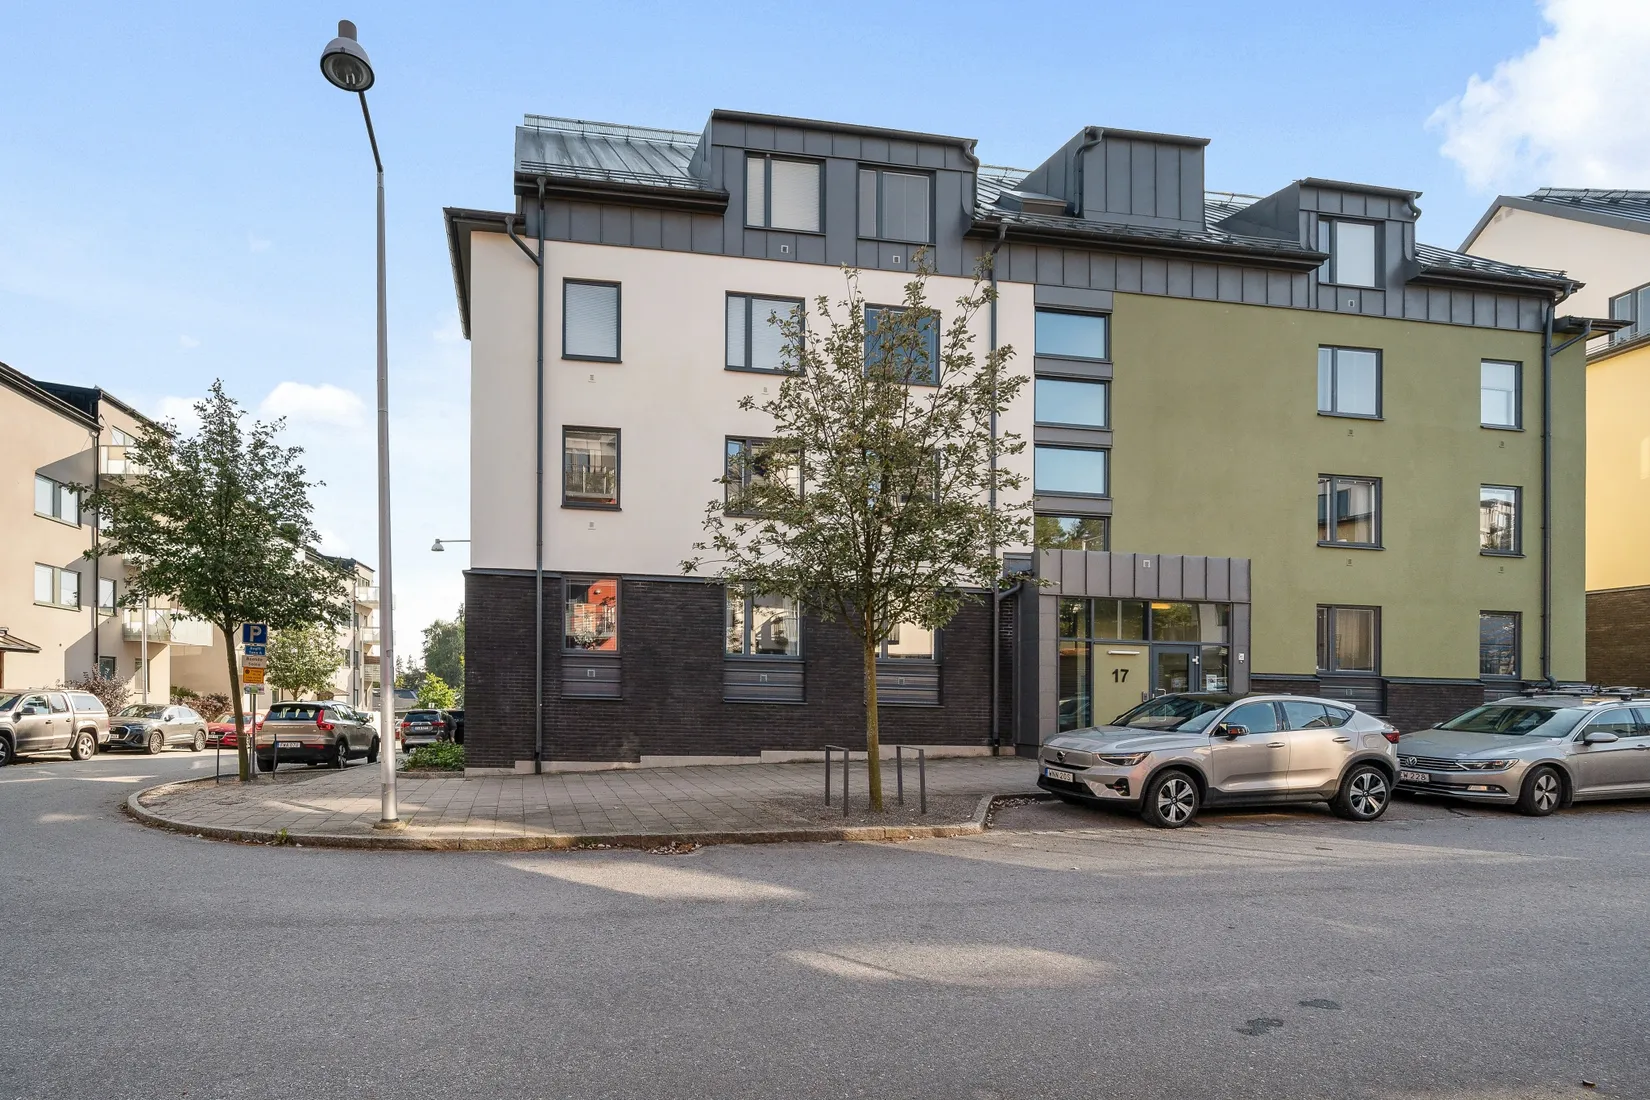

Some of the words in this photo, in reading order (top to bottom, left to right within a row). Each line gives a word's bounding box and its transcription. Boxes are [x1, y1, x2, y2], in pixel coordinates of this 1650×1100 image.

[250, 625, 261, 641] P
[1112, 669, 1129, 683] 17
[1410, 772, 1426, 781] 228
